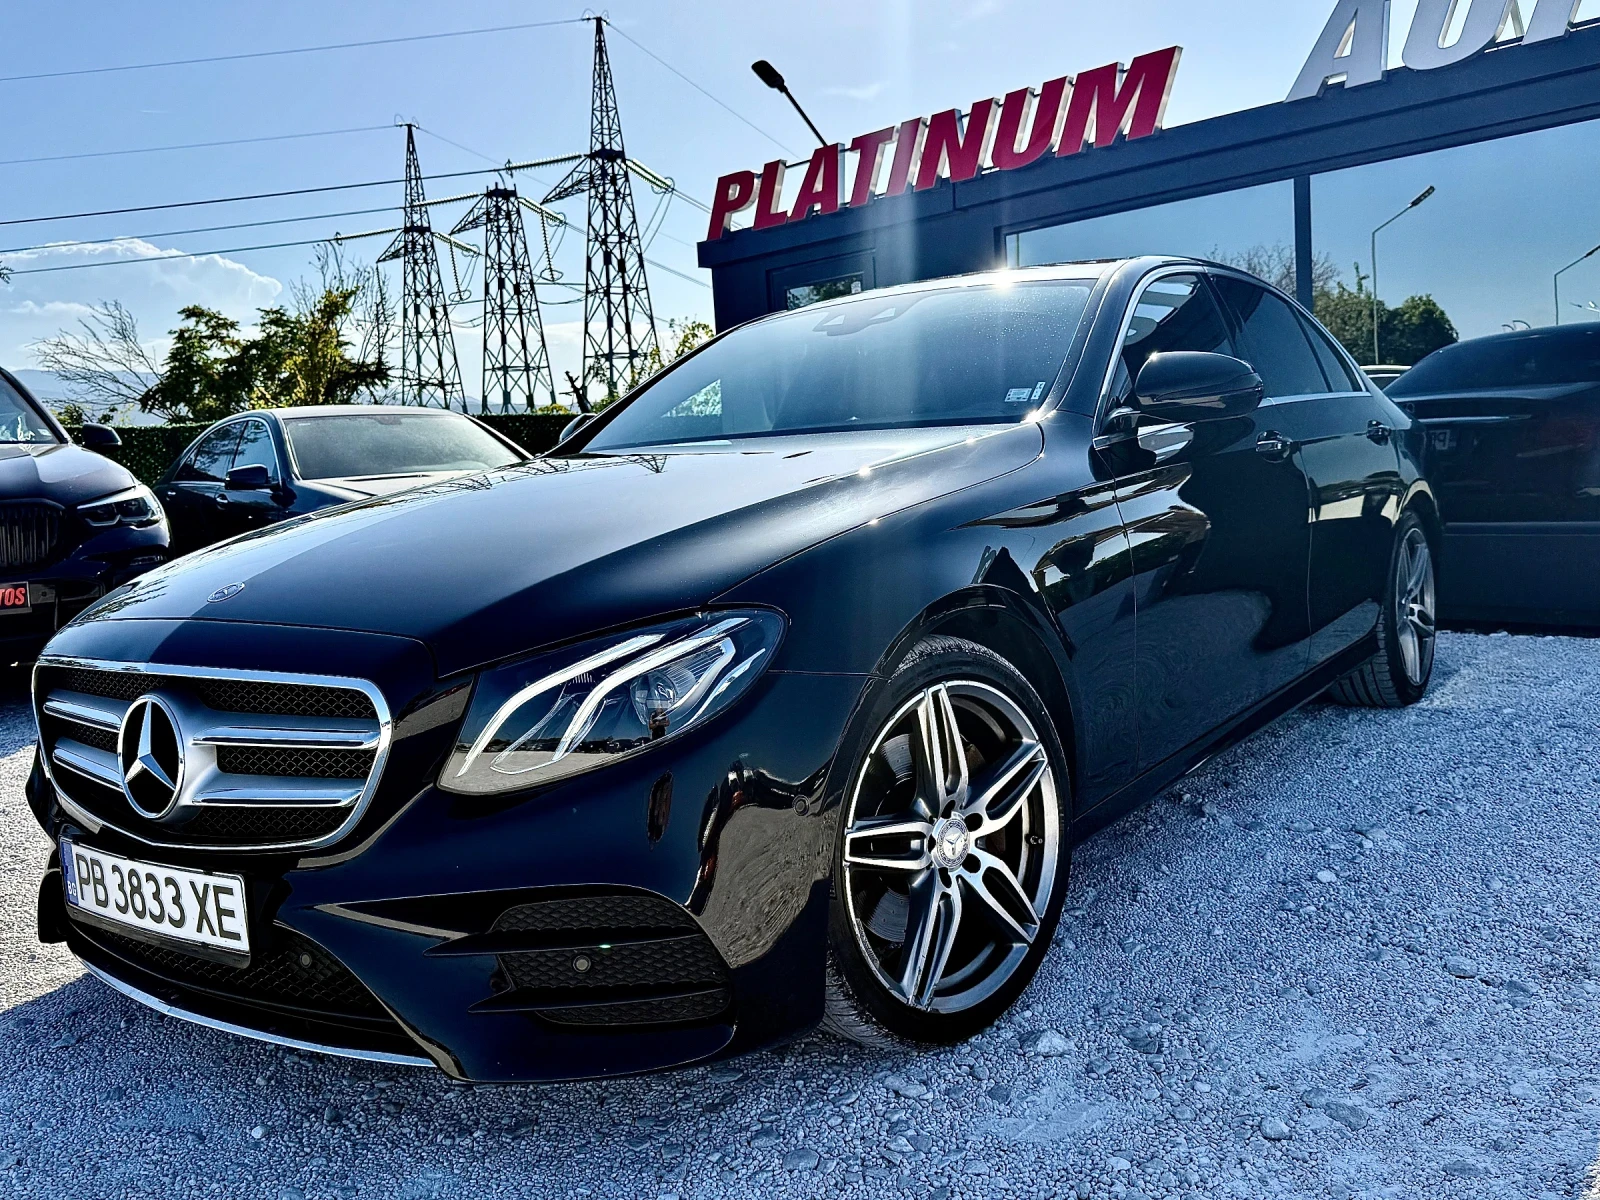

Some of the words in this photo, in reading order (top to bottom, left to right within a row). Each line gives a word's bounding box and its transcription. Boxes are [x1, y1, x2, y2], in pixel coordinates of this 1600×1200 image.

[706, 46, 1183, 241] PLATINUM
[66, 881, 77, 897] BG
[75, 853, 109, 908] PB
[111, 864, 187, 929] 3833
[189, 880, 242, 942] XE
